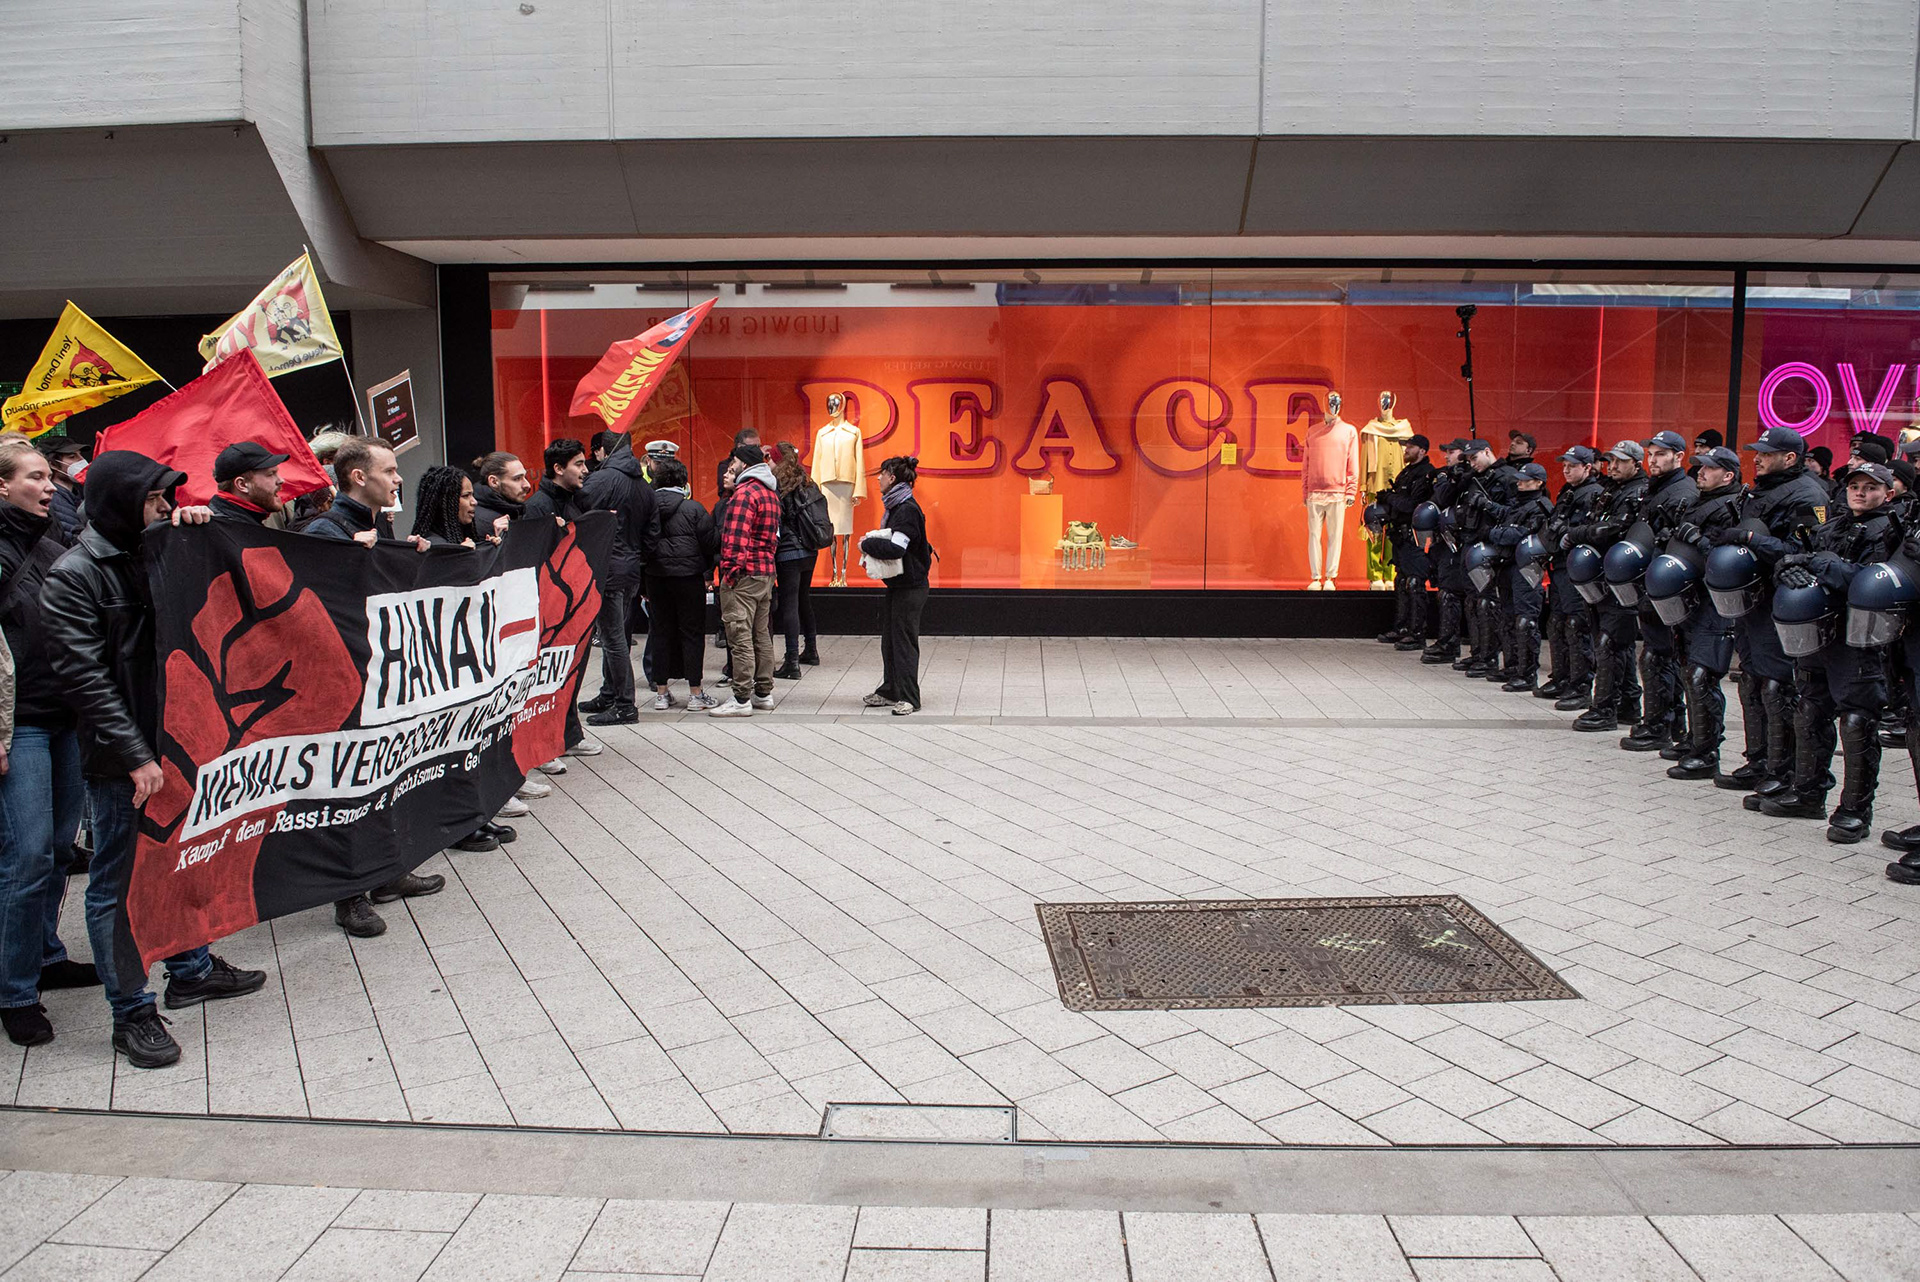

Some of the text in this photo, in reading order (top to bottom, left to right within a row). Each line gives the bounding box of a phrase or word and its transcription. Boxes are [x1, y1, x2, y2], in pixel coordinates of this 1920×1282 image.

[797, 374, 1336, 478] PEACE
[1758, 361, 1920, 438] OV
[377, 588, 497, 710] HANAU
[193, 742, 320, 827] NIEMALS
[174, 828, 232, 873] Kampf
[235, 819, 267, 844] dem
[270, 802, 372, 834] Rassismus
[375, 791, 388, 811] &
